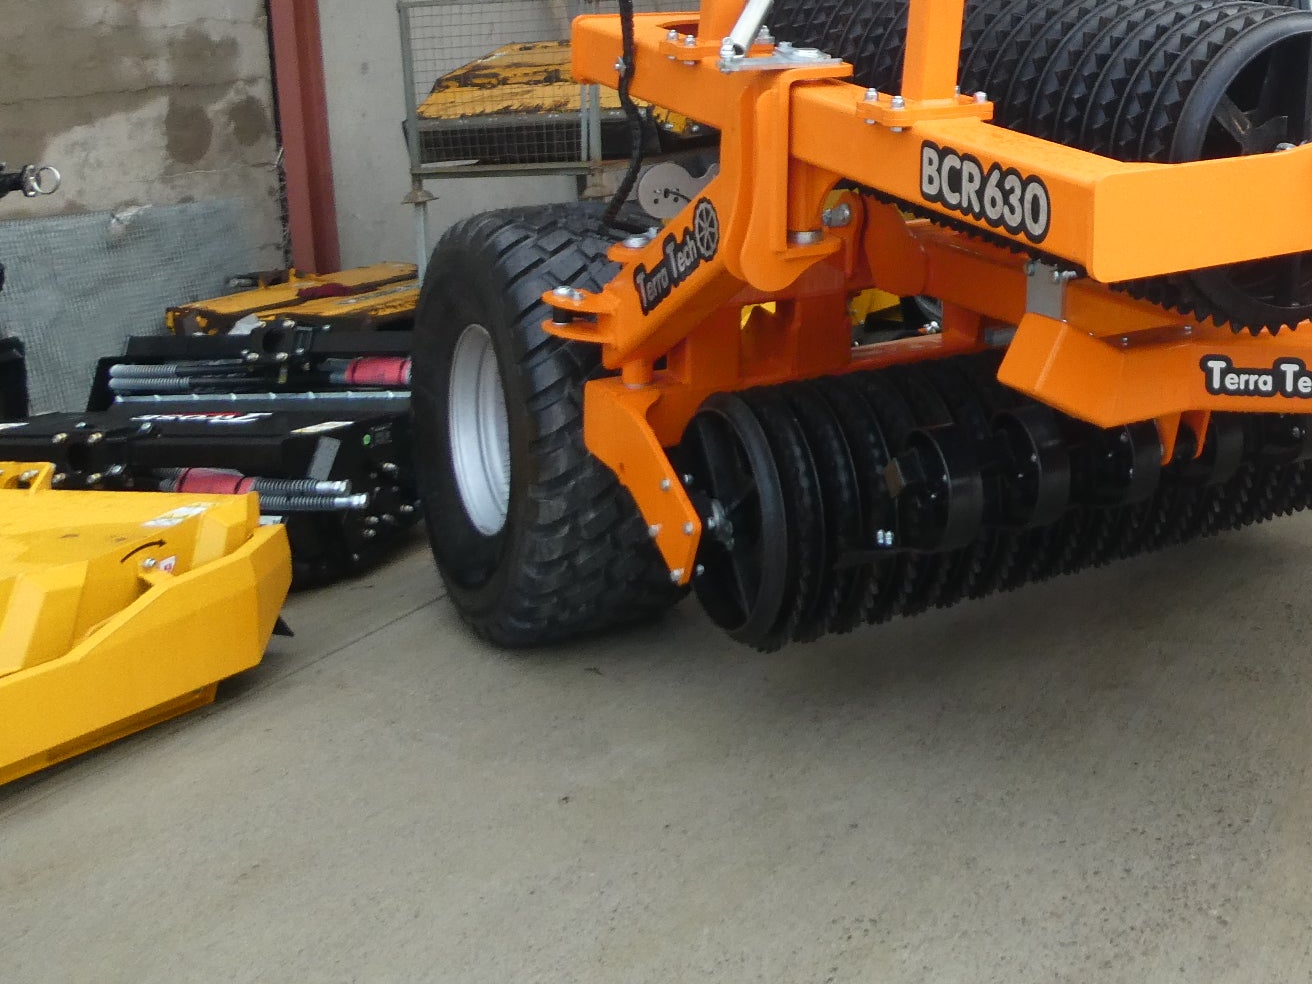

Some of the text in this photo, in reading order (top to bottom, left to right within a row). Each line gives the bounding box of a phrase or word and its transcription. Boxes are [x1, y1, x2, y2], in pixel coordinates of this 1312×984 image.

[921, 145, 1048, 236] BCR630
[635, 233, 698, 308] Terra Tech
[1207, 360, 1273, 391] Terra
